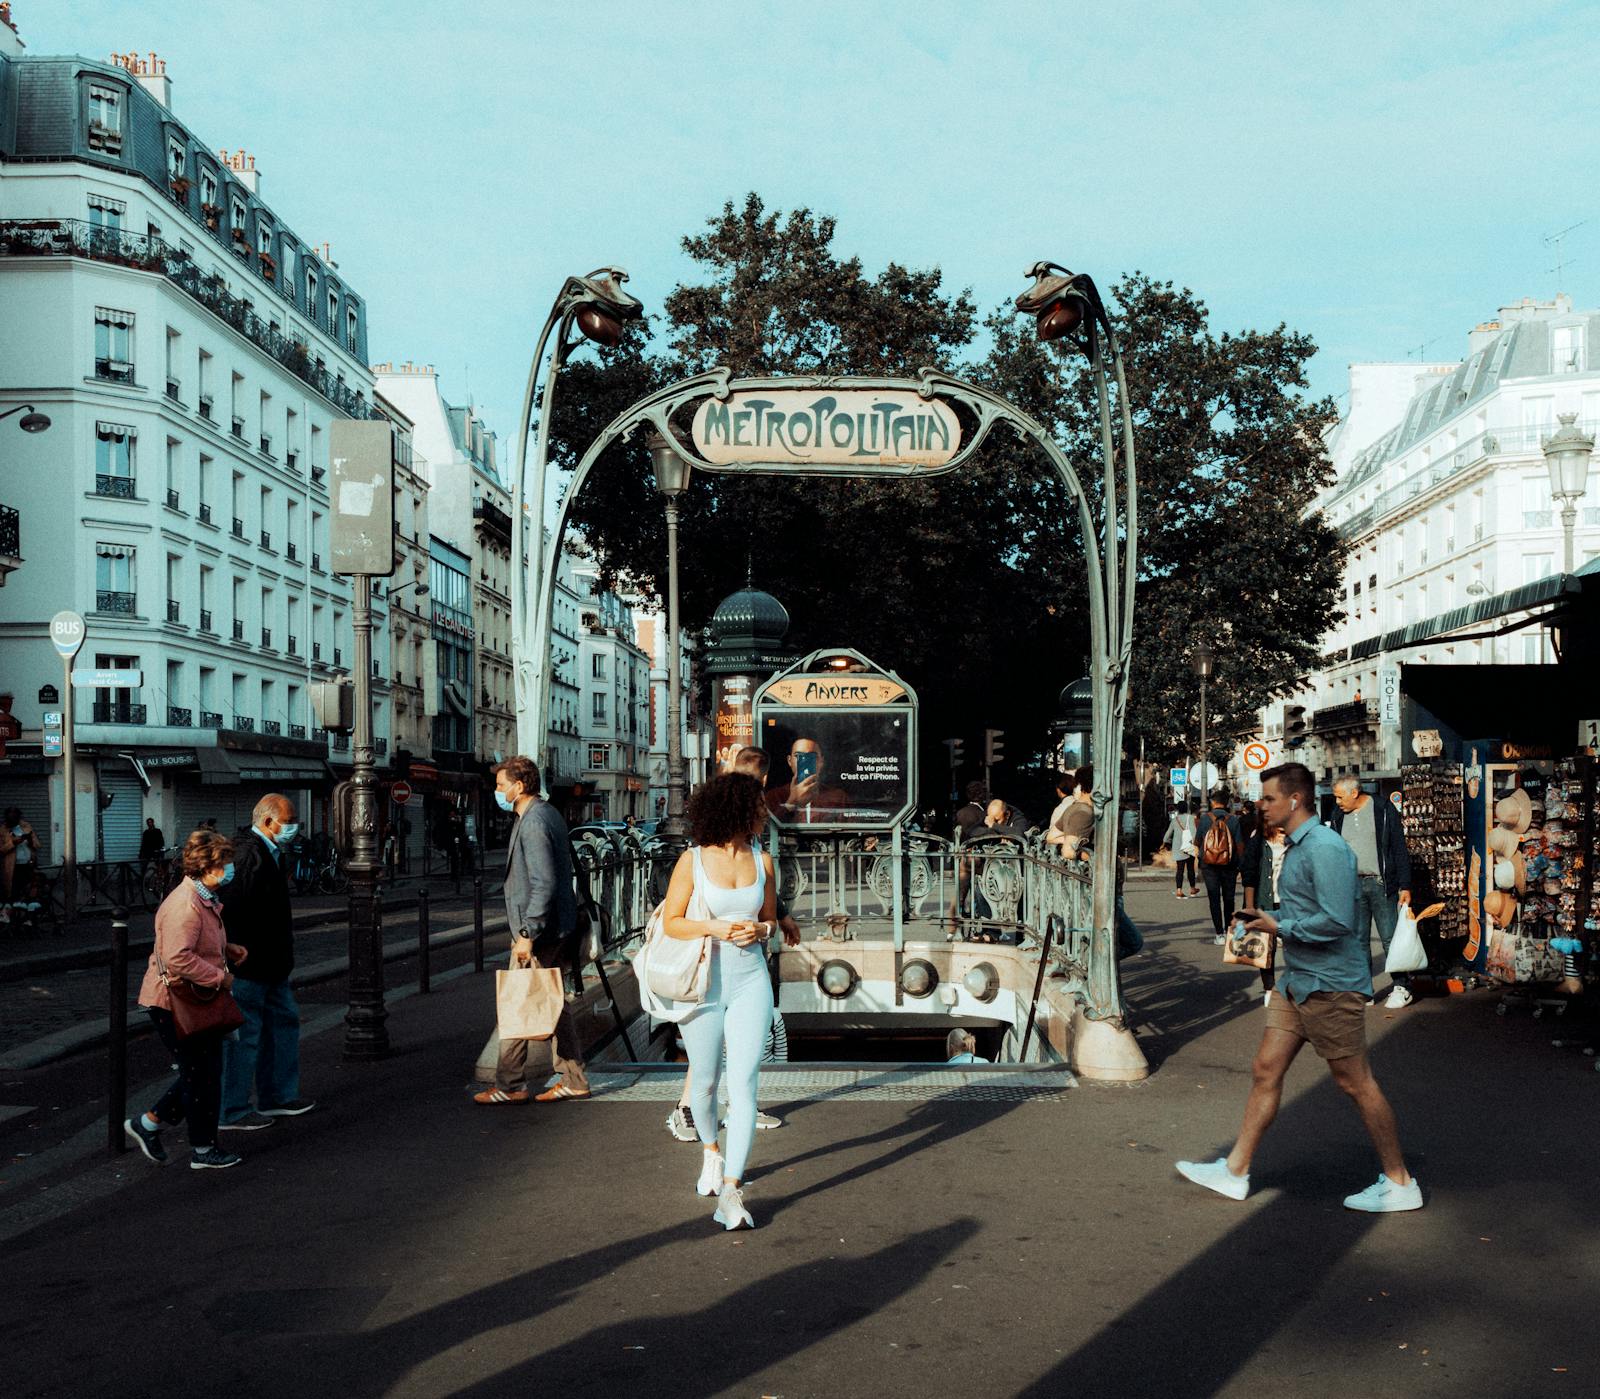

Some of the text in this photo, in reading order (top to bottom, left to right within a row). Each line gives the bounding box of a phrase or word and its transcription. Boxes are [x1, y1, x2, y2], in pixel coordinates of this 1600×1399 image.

[704, 396, 949, 457] METROPOLITAIN
[55, 621, 80, 634] BUS
[805, 682, 868, 702] ANVERS
[47, 713, 59, 722] 54
[858, 756, 887, 764] Respect
[876, 764, 900, 772] privée.
[860, 773, 869, 781] ça
[1524, 780, 1541, 788] PARIS
